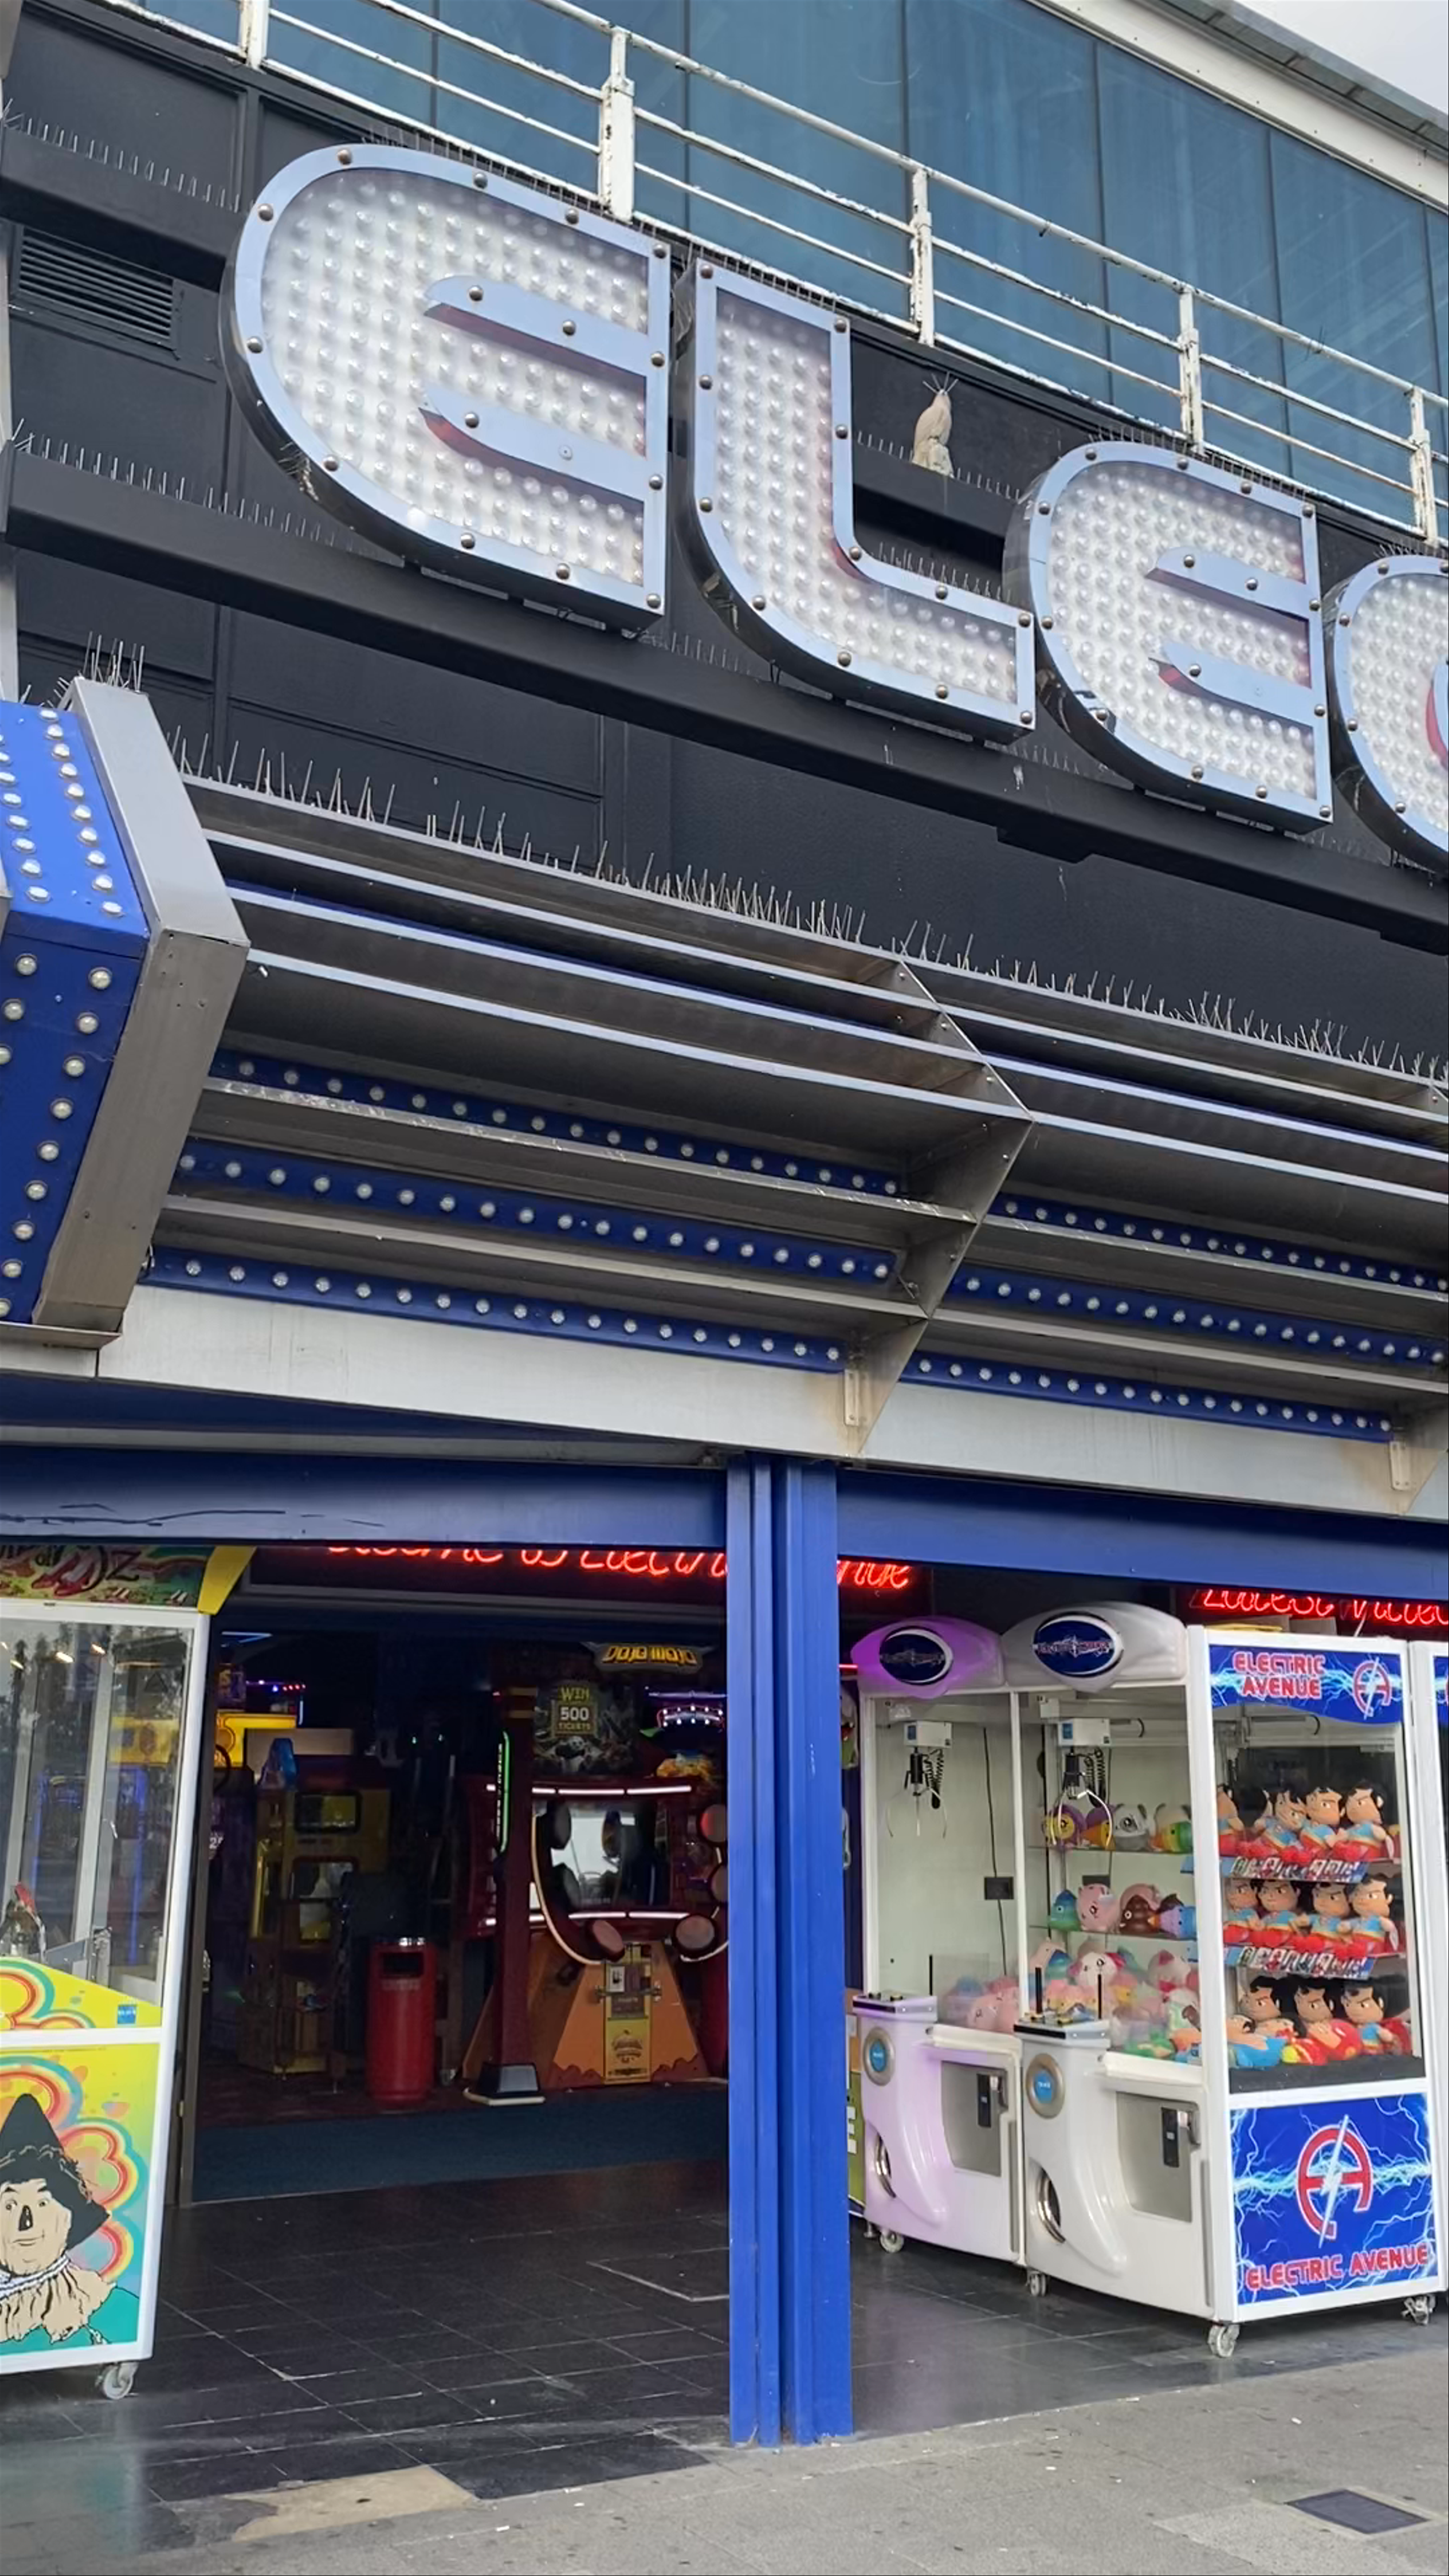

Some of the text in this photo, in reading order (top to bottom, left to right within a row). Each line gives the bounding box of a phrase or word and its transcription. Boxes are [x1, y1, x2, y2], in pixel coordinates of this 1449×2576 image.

[1232, 1651, 1326, 1675] ELECTRIC
[1241, 1676, 1321, 1699] AVENUE
[560, 1707, 589, 1722] 500
[1246, 2242, 1429, 2291] ELECTRIC AVENUE
